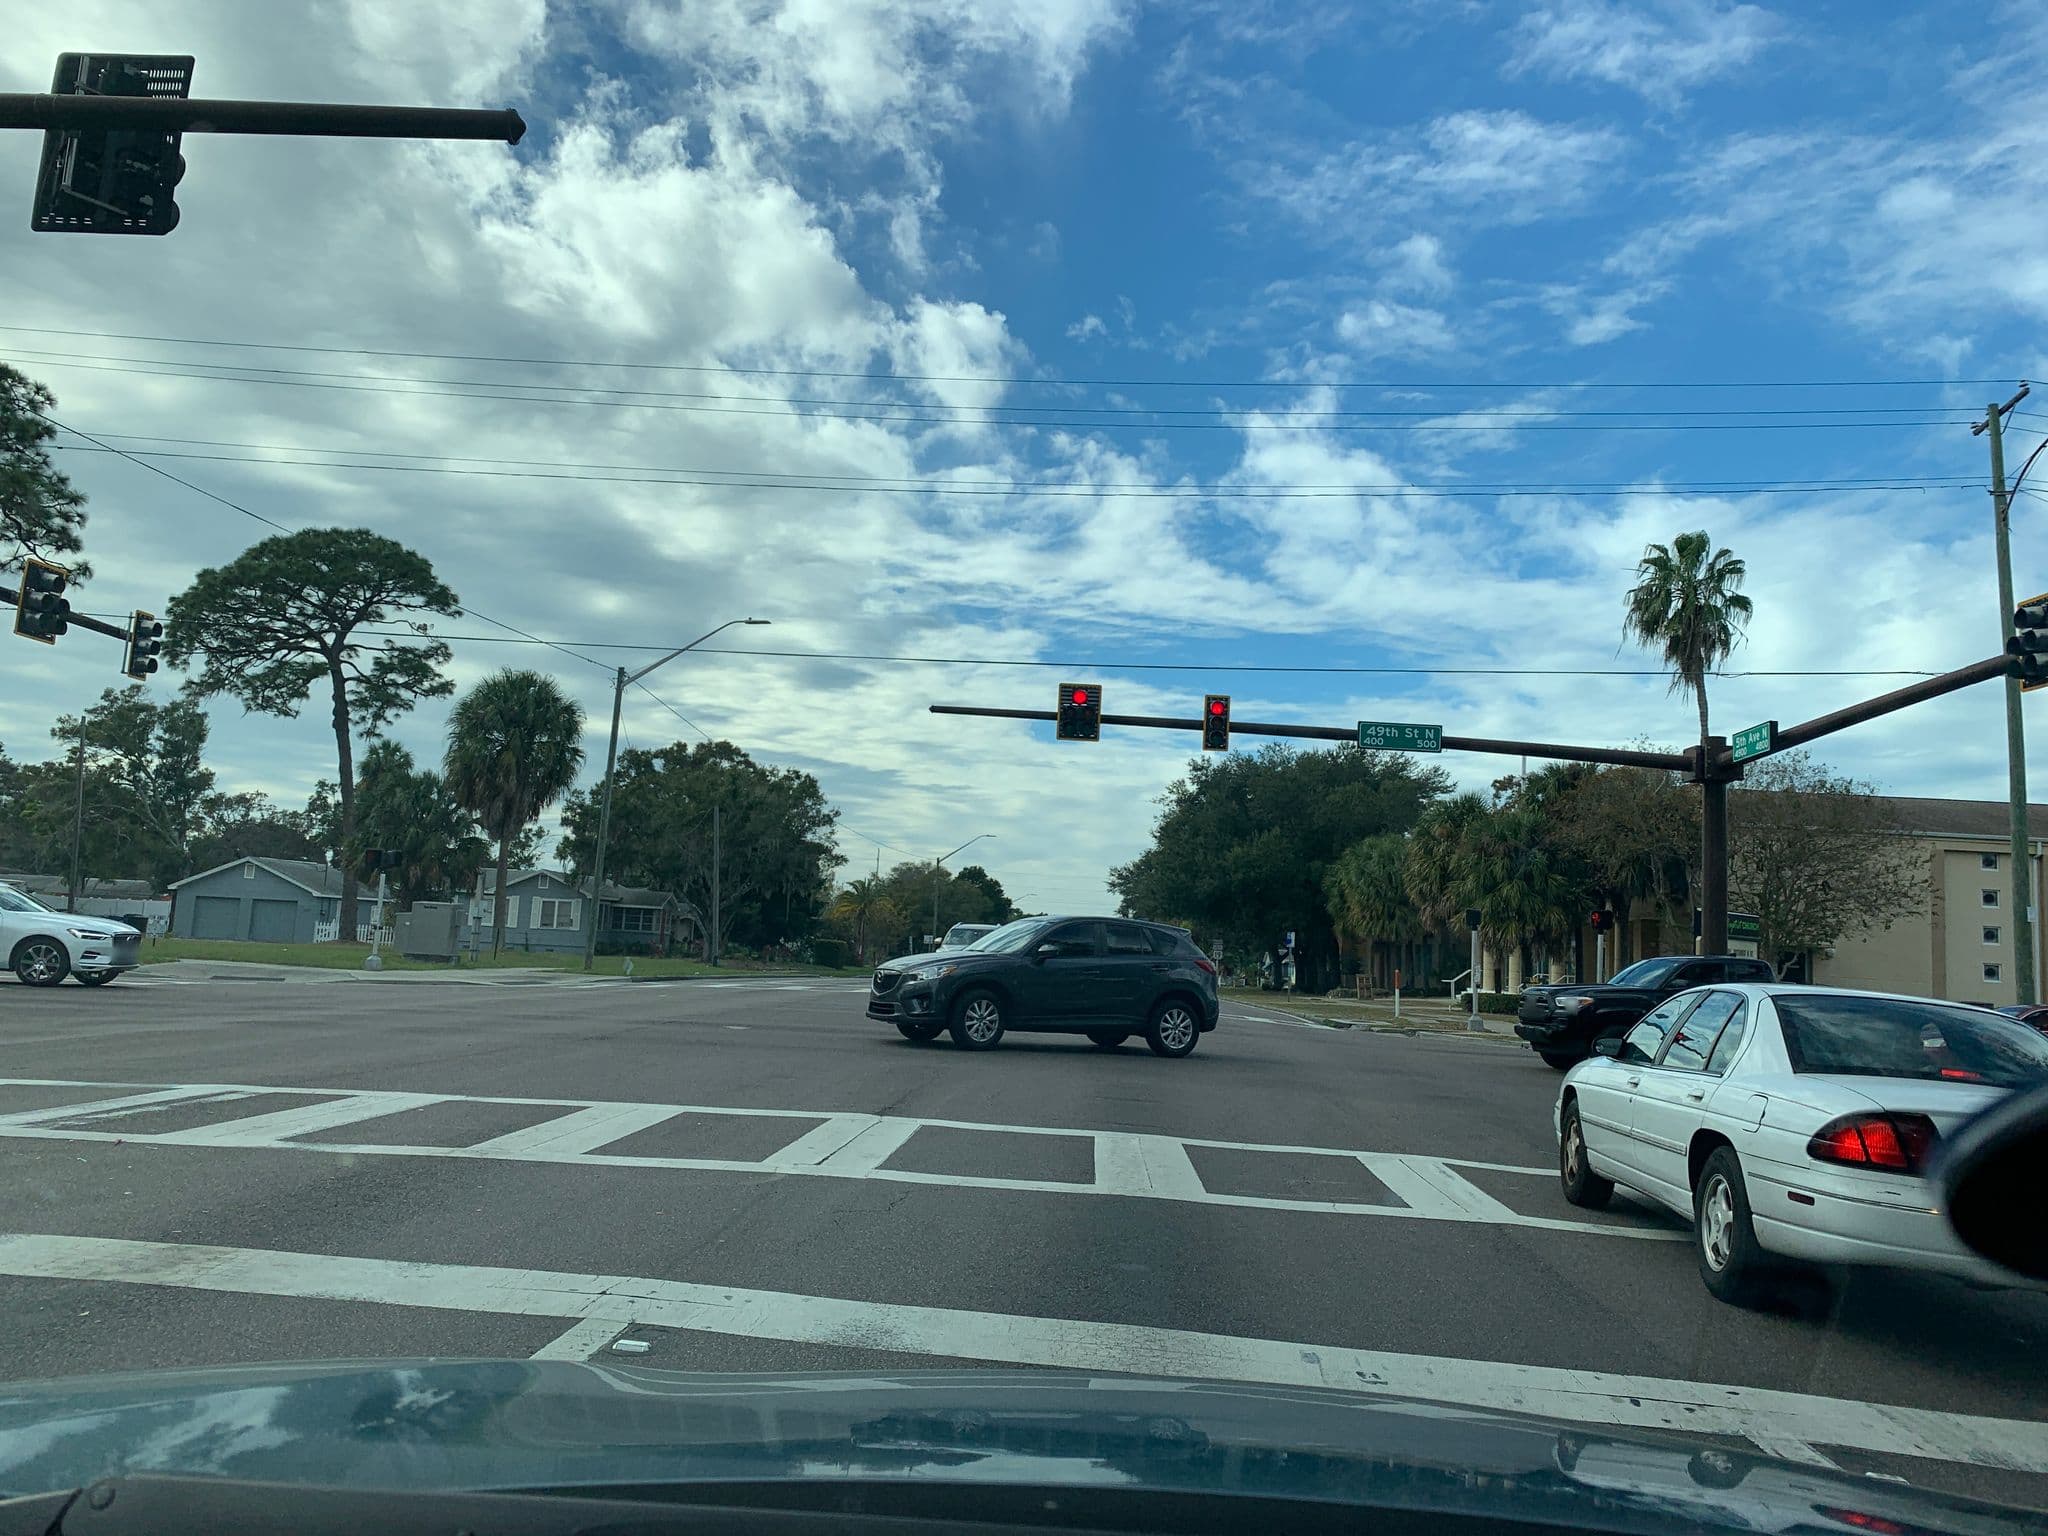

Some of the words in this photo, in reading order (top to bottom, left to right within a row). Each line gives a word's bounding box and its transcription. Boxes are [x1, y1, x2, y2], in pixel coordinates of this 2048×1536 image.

[1366, 726, 1398, 738] 49th
[1405, 727, 1420, 739] St
[1425, 728, 1434, 740] N
[1735, 735, 1747, 749] 5th
[1748, 731, 1760, 745] Ave
[1761, 726, 1768, 739] N
[1363, 737, 1384, 746] 400
[1416, 739, 1437, 748] 500
